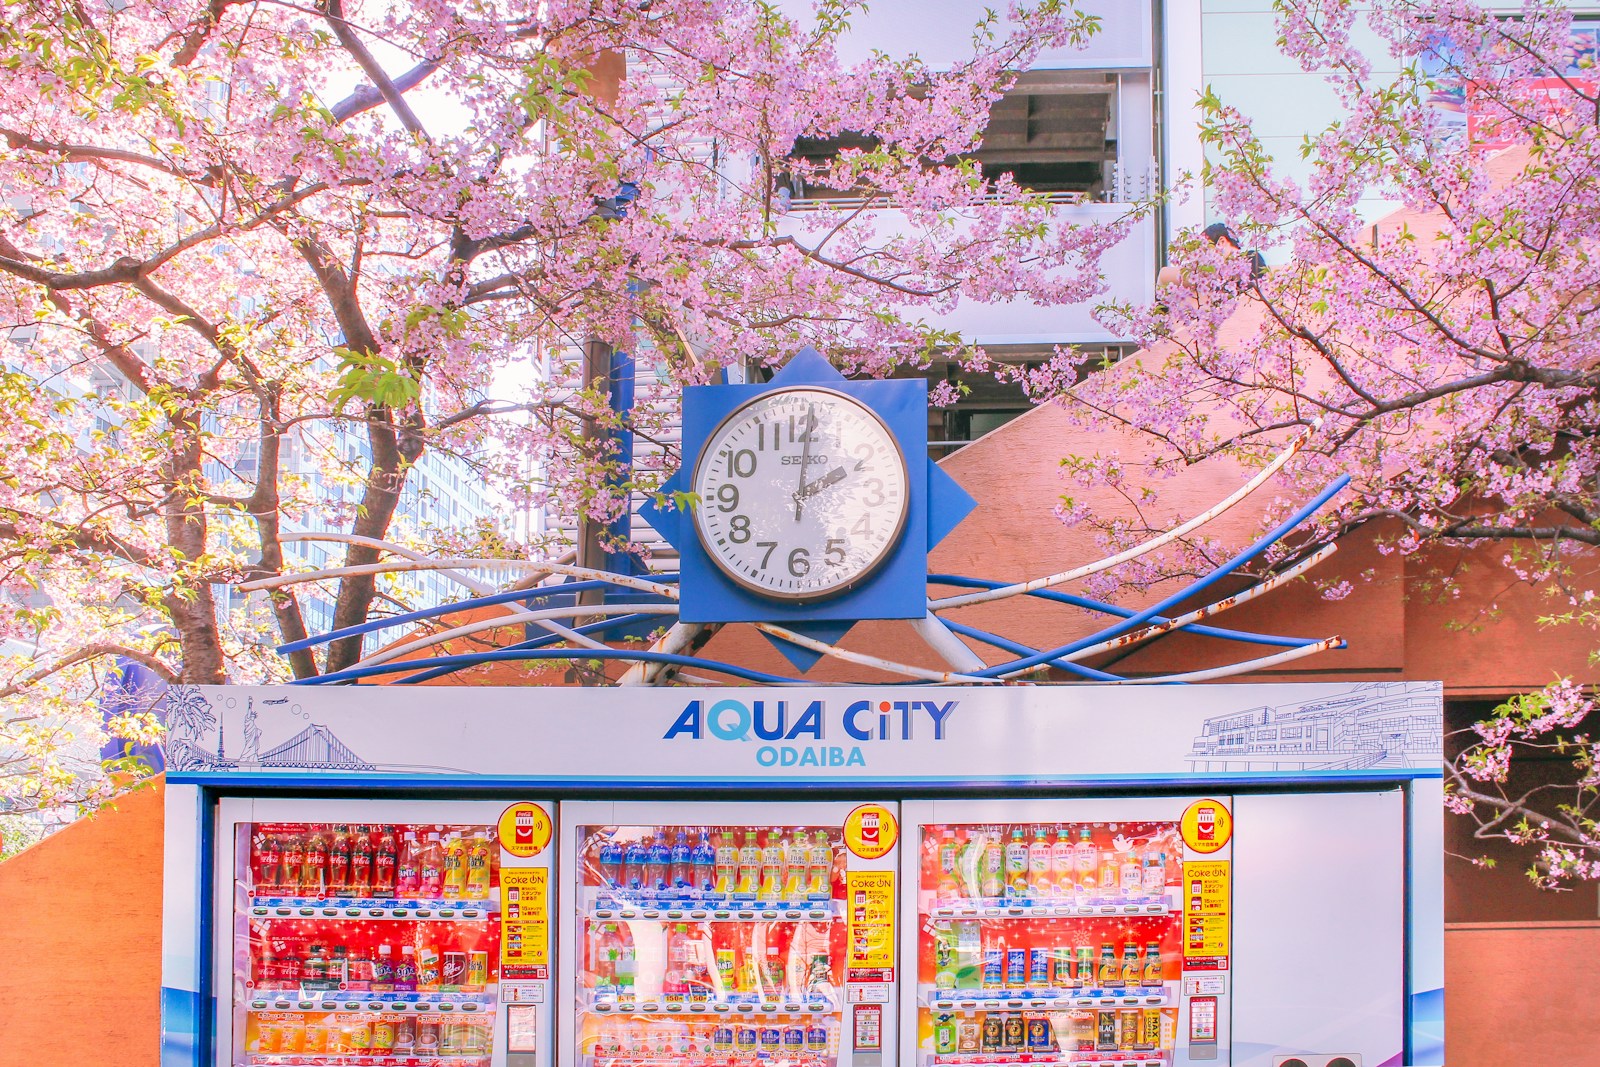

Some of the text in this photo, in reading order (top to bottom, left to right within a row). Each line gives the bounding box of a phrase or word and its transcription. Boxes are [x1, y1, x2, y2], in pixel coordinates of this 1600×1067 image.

[759, 423, 780, 451] 11
[789, 414, 818, 442] 12
[728, 449, 757, 478] 10
[781, 455, 828, 466] SEKO
[853, 443, 875, 472] 2
[717, 484, 739, 512] 9
[863, 478, 885, 508] 3
[729, 515, 751, 544] 8
[851, 512, 874, 541] 4
[756, 541, 778, 570] 7
[788, 548, 810, 577] 6
[824, 539, 847, 566] 5
[662, 699, 826, 741] AQUA
[756, 745, 866, 767] ODAIBA
[503, 876, 528, 884] Coke
[851, 879, 875, 888] Coke
[1187, 869, 1211, 877] Coke
